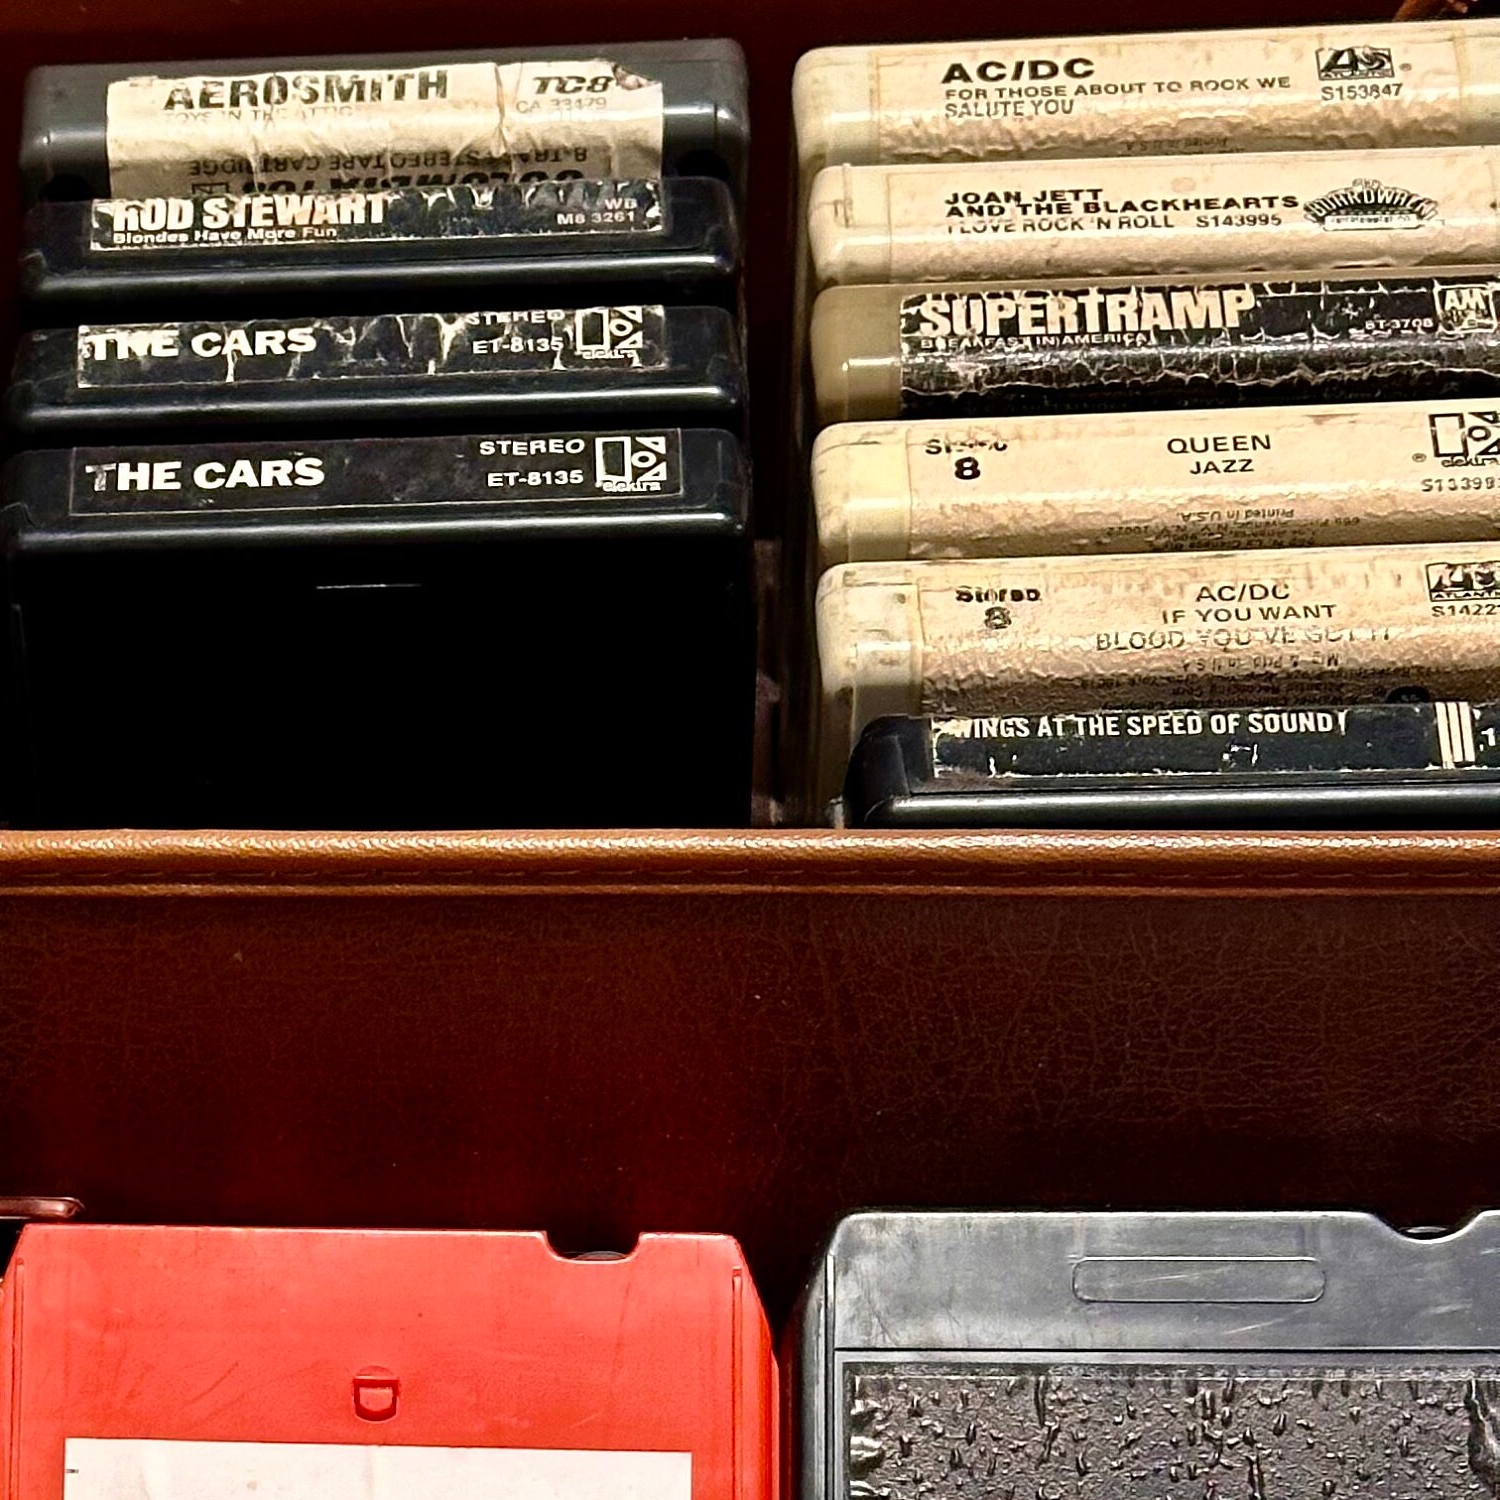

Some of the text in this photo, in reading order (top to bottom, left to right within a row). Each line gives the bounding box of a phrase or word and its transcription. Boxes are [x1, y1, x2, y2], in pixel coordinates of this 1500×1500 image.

[941, 58, 1095, 84] AC/DC
[164, 70, 448, 110] AEROSMITH
[533, 75, 614, 95] TC8
[946, 77, 1291, 100] FOR THOSE ABOUT TO ROCK WE
[945, 99, 1074, 119] SALUTE YOU
[329, 155, 384, 171] TAPE
[945, 188, 1103, 205] JOAN JETT
[947, 196, 1299, 217] AND THE BLACKHEARTS
[113, 192, 389, 232] ROD STEWART
[557, 211, 635, 225] M8 3261
[1023, 217, 1085, 232] ROCK
[1118, 214, 1175, 230] ROLL
[1196, 214, 1282, 228] S143995
[113, 226, 337, 244] Blondes Have More Fun
[465, 308, 566, 325] STEREO
[920, 289, 1256, 337] SUPERTRAMP
[191, 327, 317, 357] CARS
[472, 337, 565, 354] ET-8135
[1062, 332, 1148, 346] AMERICA
[479, 438, 585, 456] STEREO
[1167, 435, 1271, 455] QUEEN
[85, 457, 325, 492] THE CARS
[954, 457, 981, 480] 8
[1189, 459, 1255, 475] JAZZ
[487, 470, 584, 487] ET-8135
[1227, 509, 1241, 520] in
[1244, 508, 1294, 521] Printed
[1195, 583, 1290, 602] AC/DC
[984, 606, 1012, 629] 8
[1162, 604, 1337, 624] IF YOU WANT
[1096, 630, 1186, 651] BLOOD
[1037, 716, 1067, 737] AT
[1076, 715, 1120, 737] THE
[1127, 714, 1203, 736] SPEED
[1210, 713, 1240, 734] OF
[1248, 712, 1333, 734] SOUND
